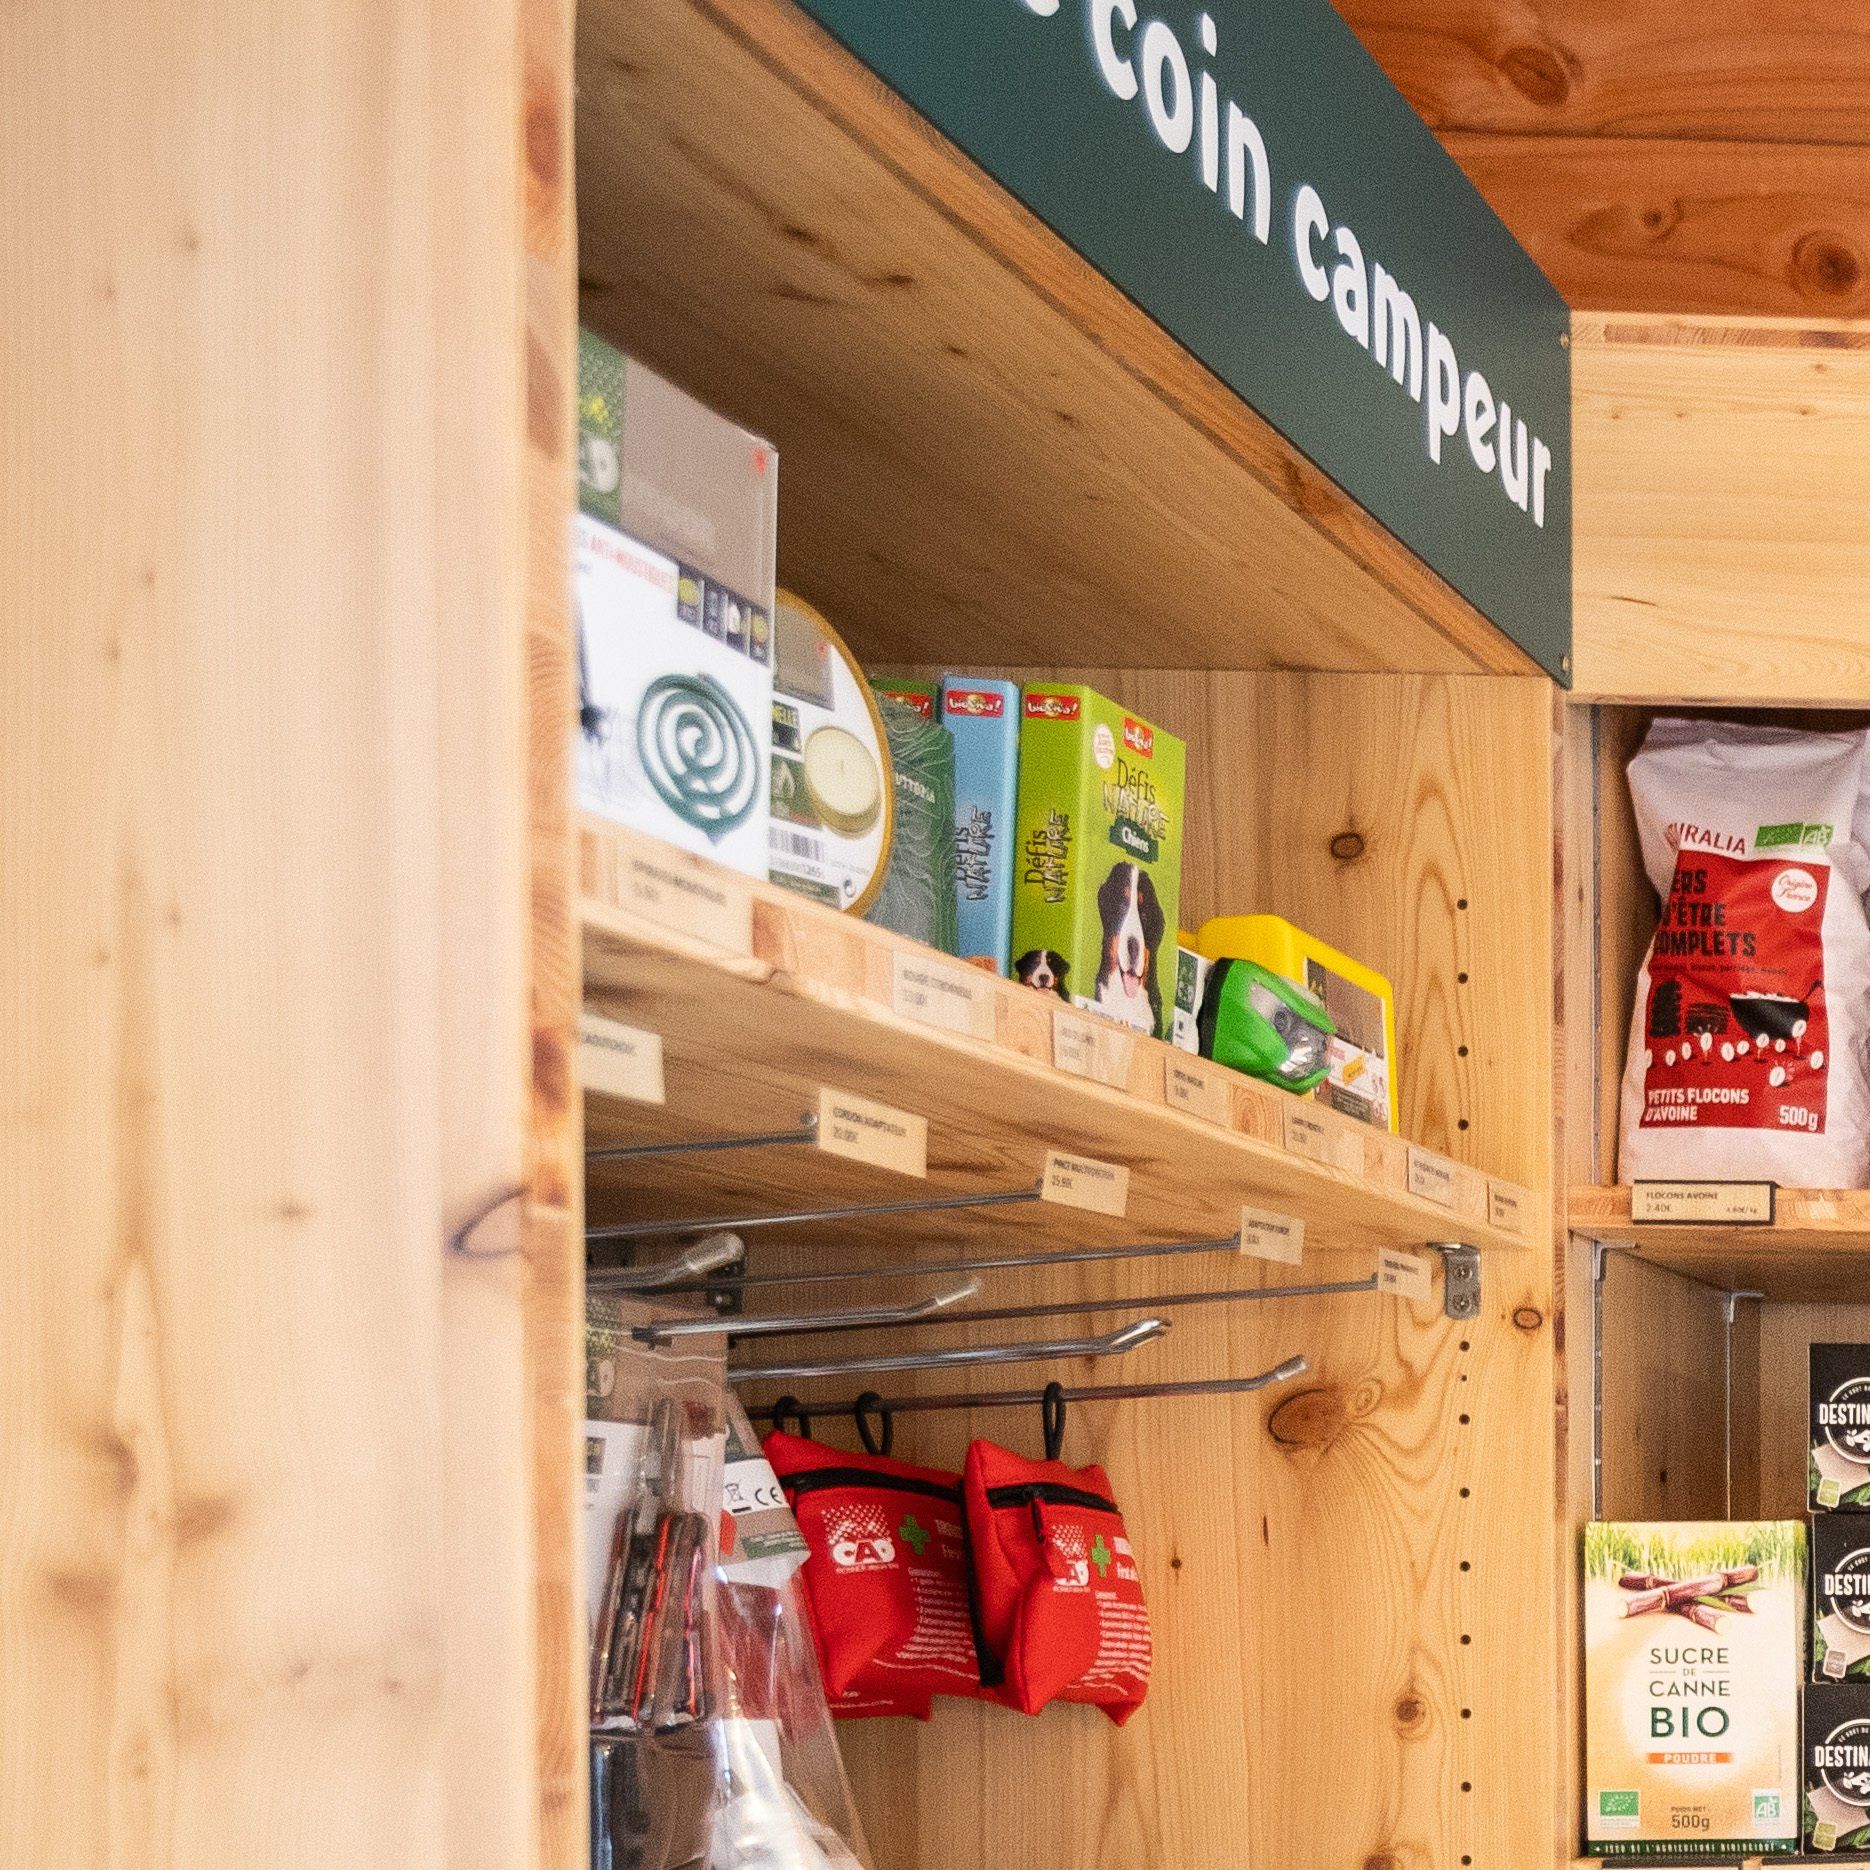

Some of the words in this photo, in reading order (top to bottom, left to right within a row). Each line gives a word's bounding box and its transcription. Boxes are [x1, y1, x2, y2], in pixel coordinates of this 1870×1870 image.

[1089, 0, 1272, 247] coin
[1292, 183, 1553, 530] campeur
[1118, 758, 1156, 802] Défis
[1688, 1088, 1750, 1104] FLOCONS
[1778, 1106, 1818, 1131] 500g
[1645, 1191, 1685, 1201] FLOCONS
[1650, 1647, 1729, 1664] SUCRE
[1649, 1679, 1731, 1697] CANNE
[1650, 1705, 1731, 1739] BIO
[1663, 1752, 1717, 1763] POUDRE
[1672, 1813, 1710, 1831] 500g
